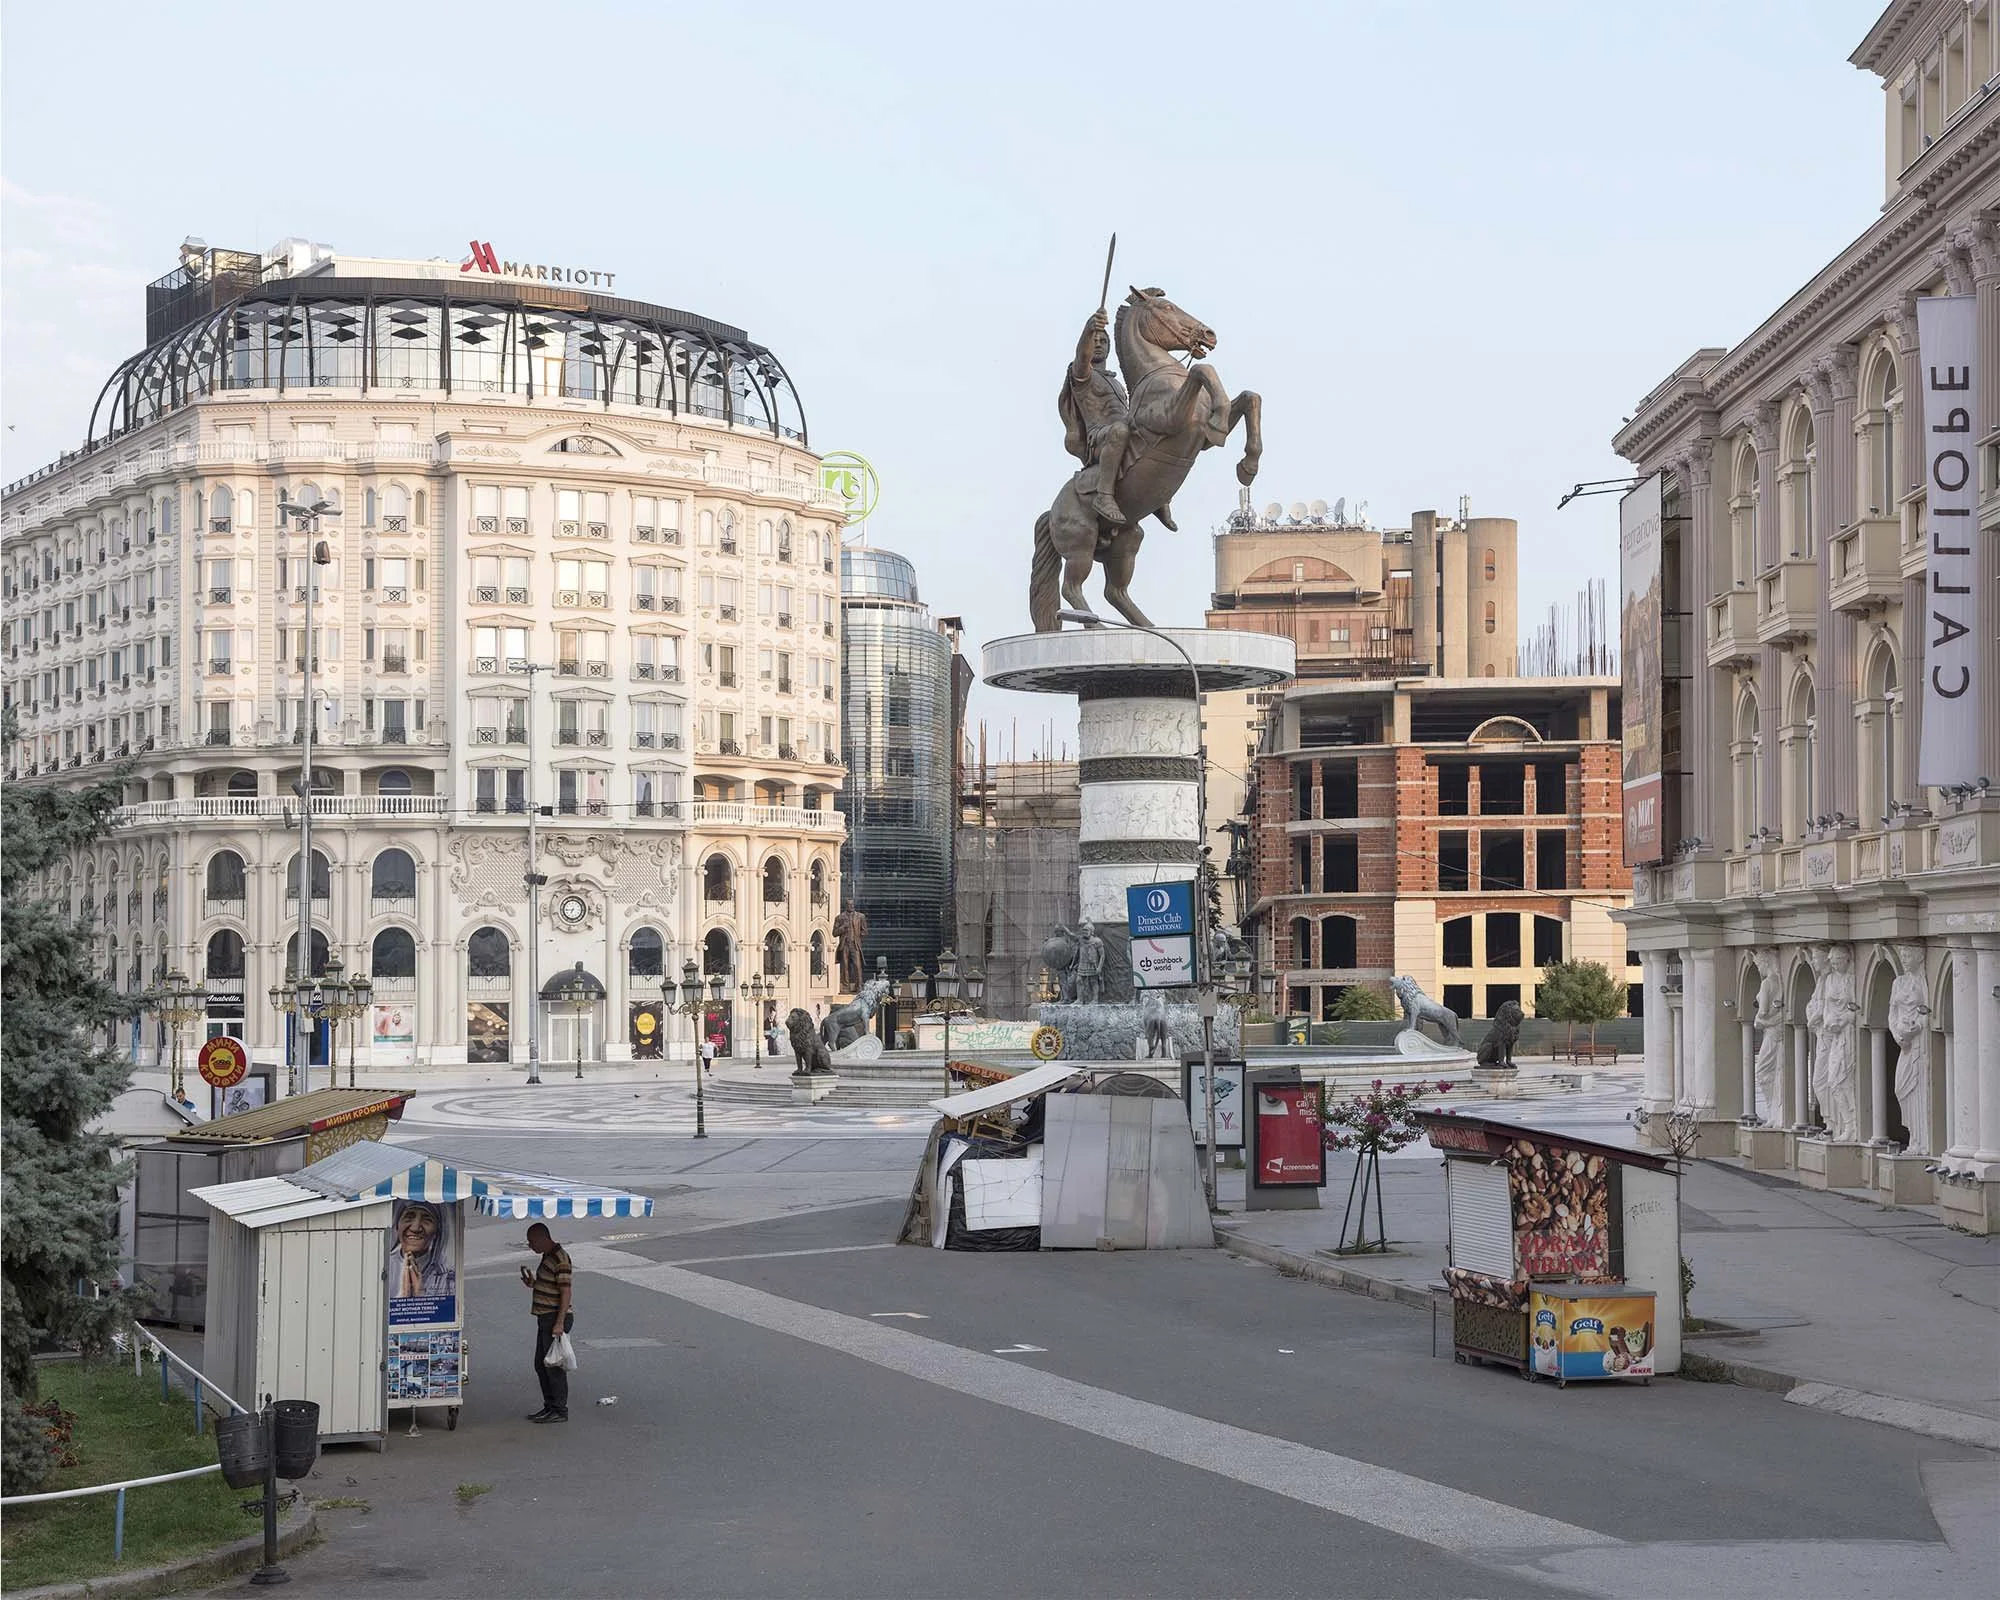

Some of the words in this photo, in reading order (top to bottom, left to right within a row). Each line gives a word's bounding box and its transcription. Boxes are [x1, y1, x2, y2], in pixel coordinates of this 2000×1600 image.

[503, 260, 616, 288] MARRIOTT
[1137, 914, 1162, 926] Diners
[1163, 912, 1182, 924] Club
[1137, 923, 1182, 933] INTERNATIONAL
[1140, 957, 1152, 968] cb
[1153, 955, 1183, 965] cashback
[1153, 964, 1172, 972] world
[206, 1038, 240, 1053] МИНИ
[200, 1064, 244, 1087] КРОФНИ
[326, 1113, 352, 1127] МИНИ
[353, 1101, 390, 1119] КРОФНИ
